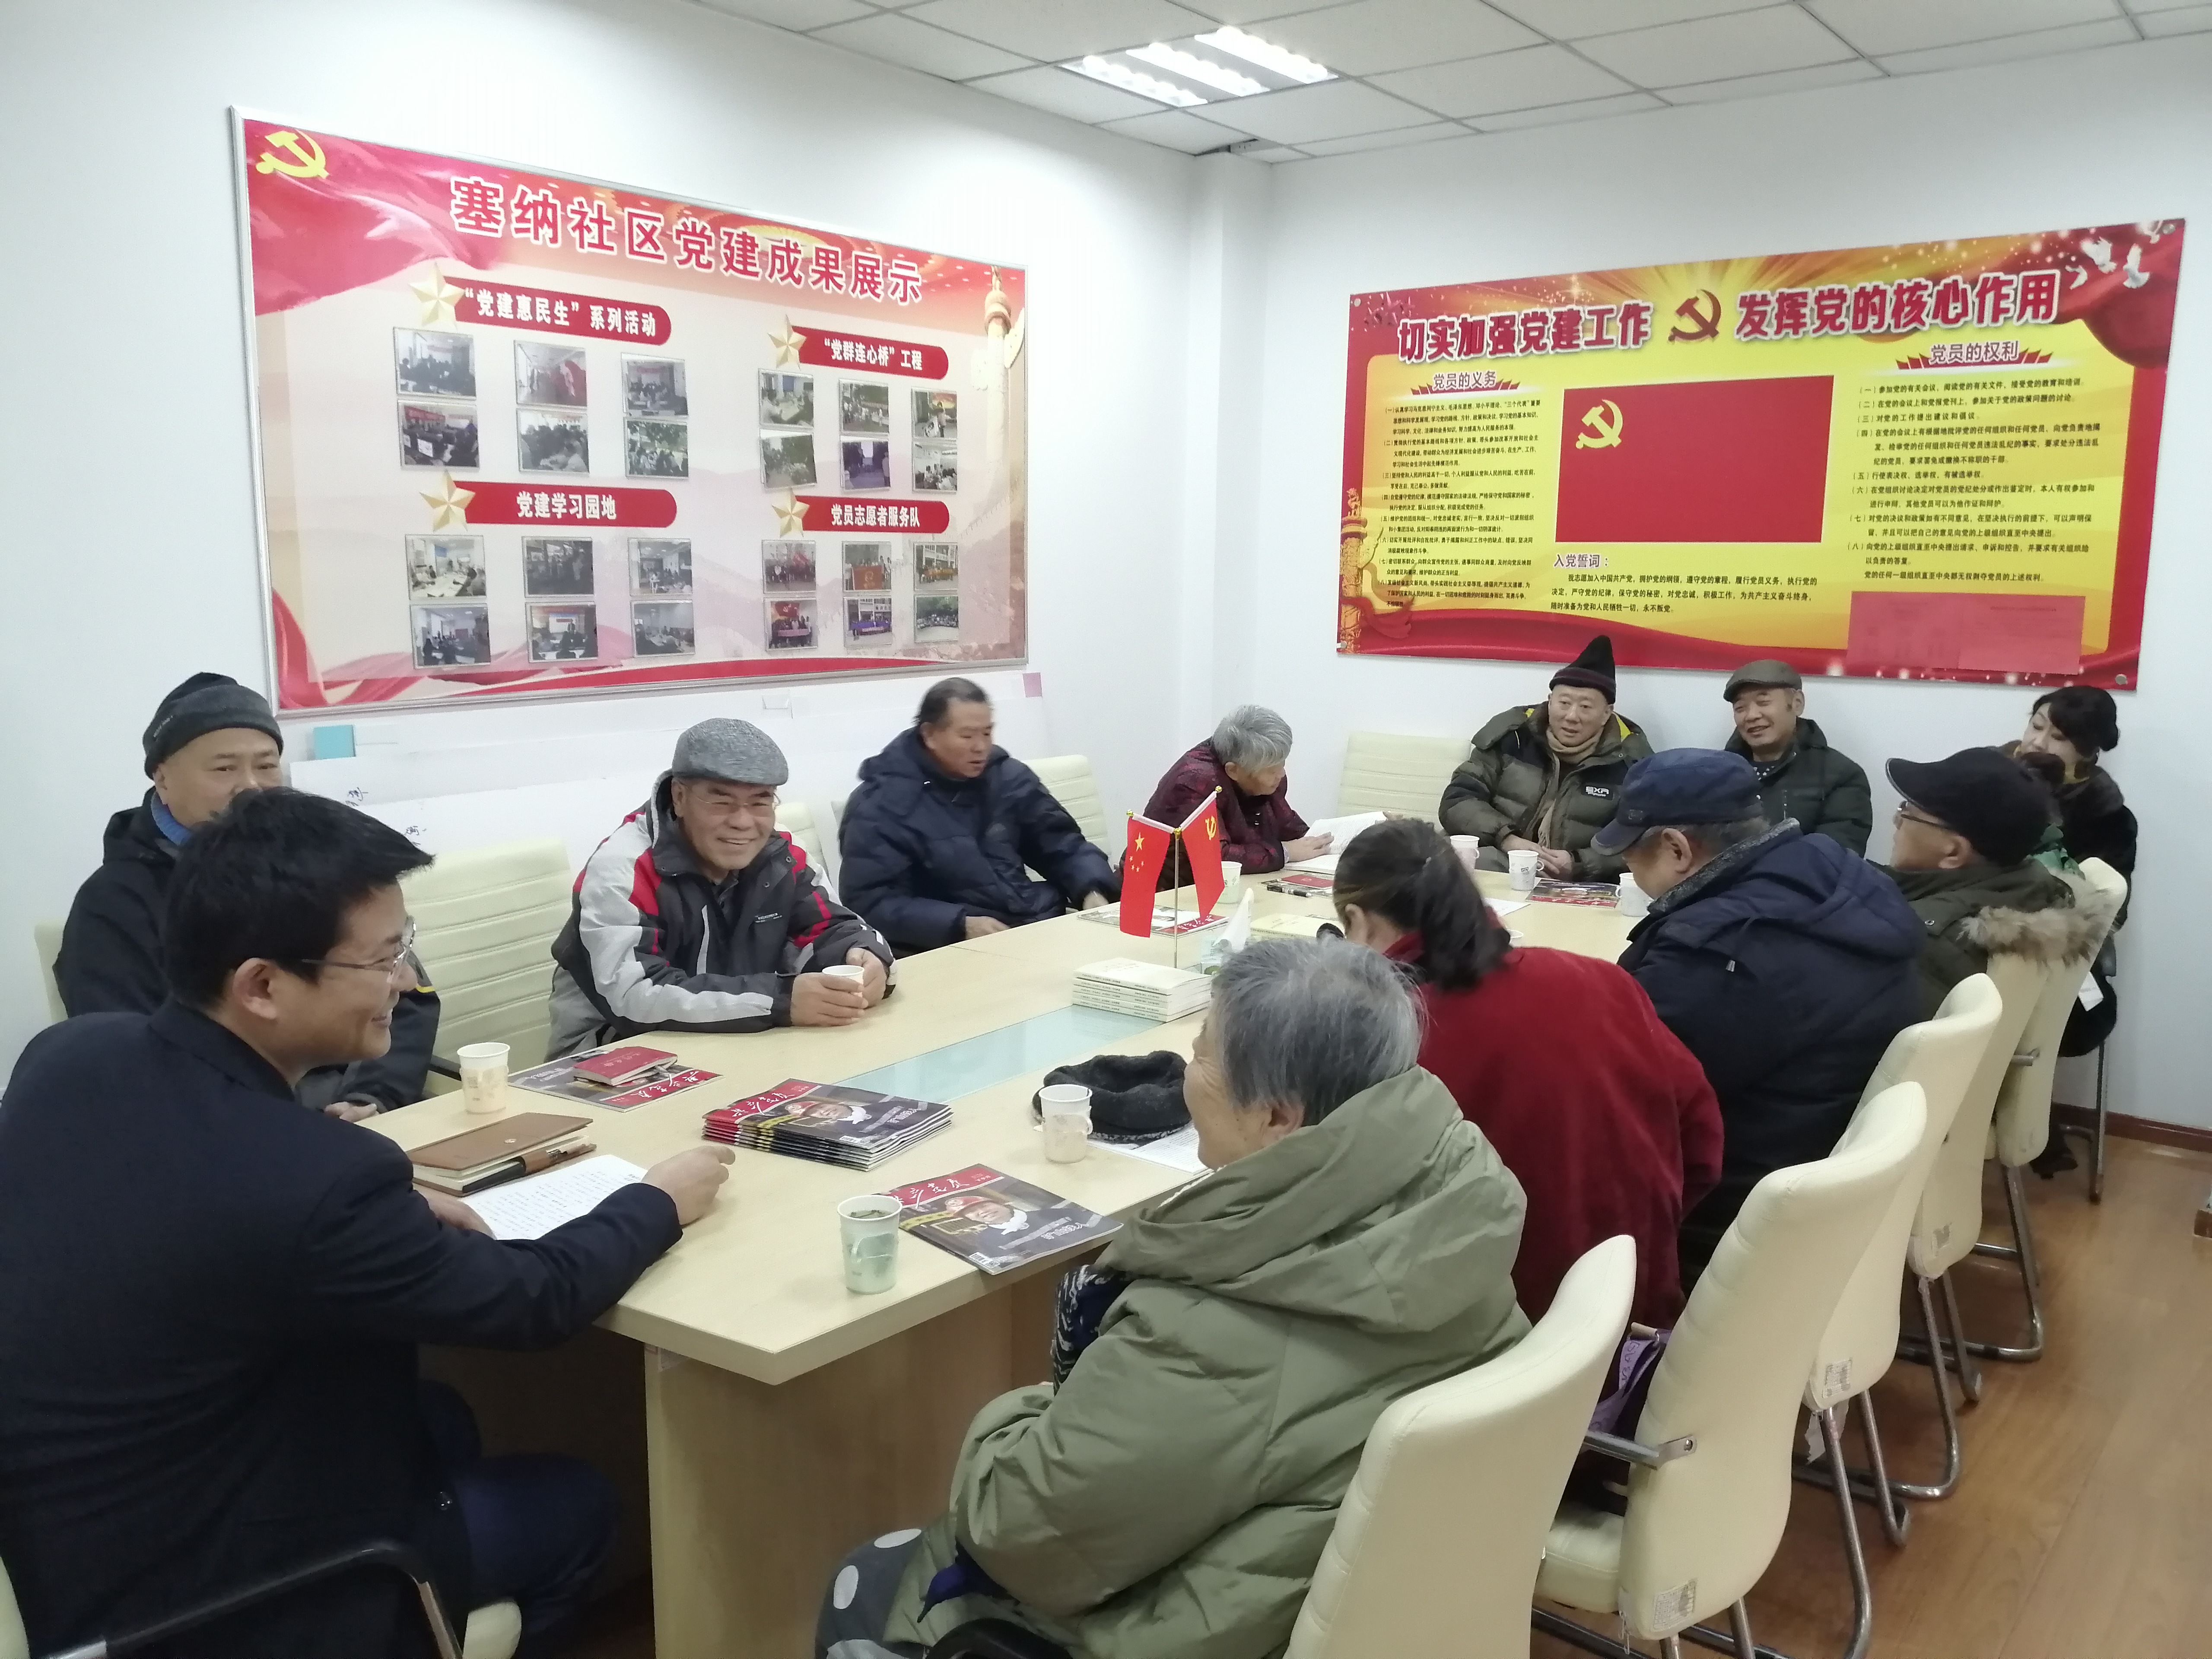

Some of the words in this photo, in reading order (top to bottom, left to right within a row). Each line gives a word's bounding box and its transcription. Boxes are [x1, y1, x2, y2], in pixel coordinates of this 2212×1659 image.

[451, 176, 922, 306] 塞纳社区党建成果展示
[1735, 269, 2060, 341] 发挥党的核心作用
[1397, 301, 1653, 363] 切实加强党建工作
[1928, 340, 2019, 365] 党员的权利
[1433, 370, 1497, 391] 党员的义务
[516, 491, 617, 519] 党建学习园地
[831, 504, 920, 527] 党员志愿者服务队
[1554, 554, 1608, 567] 入党誓词：
